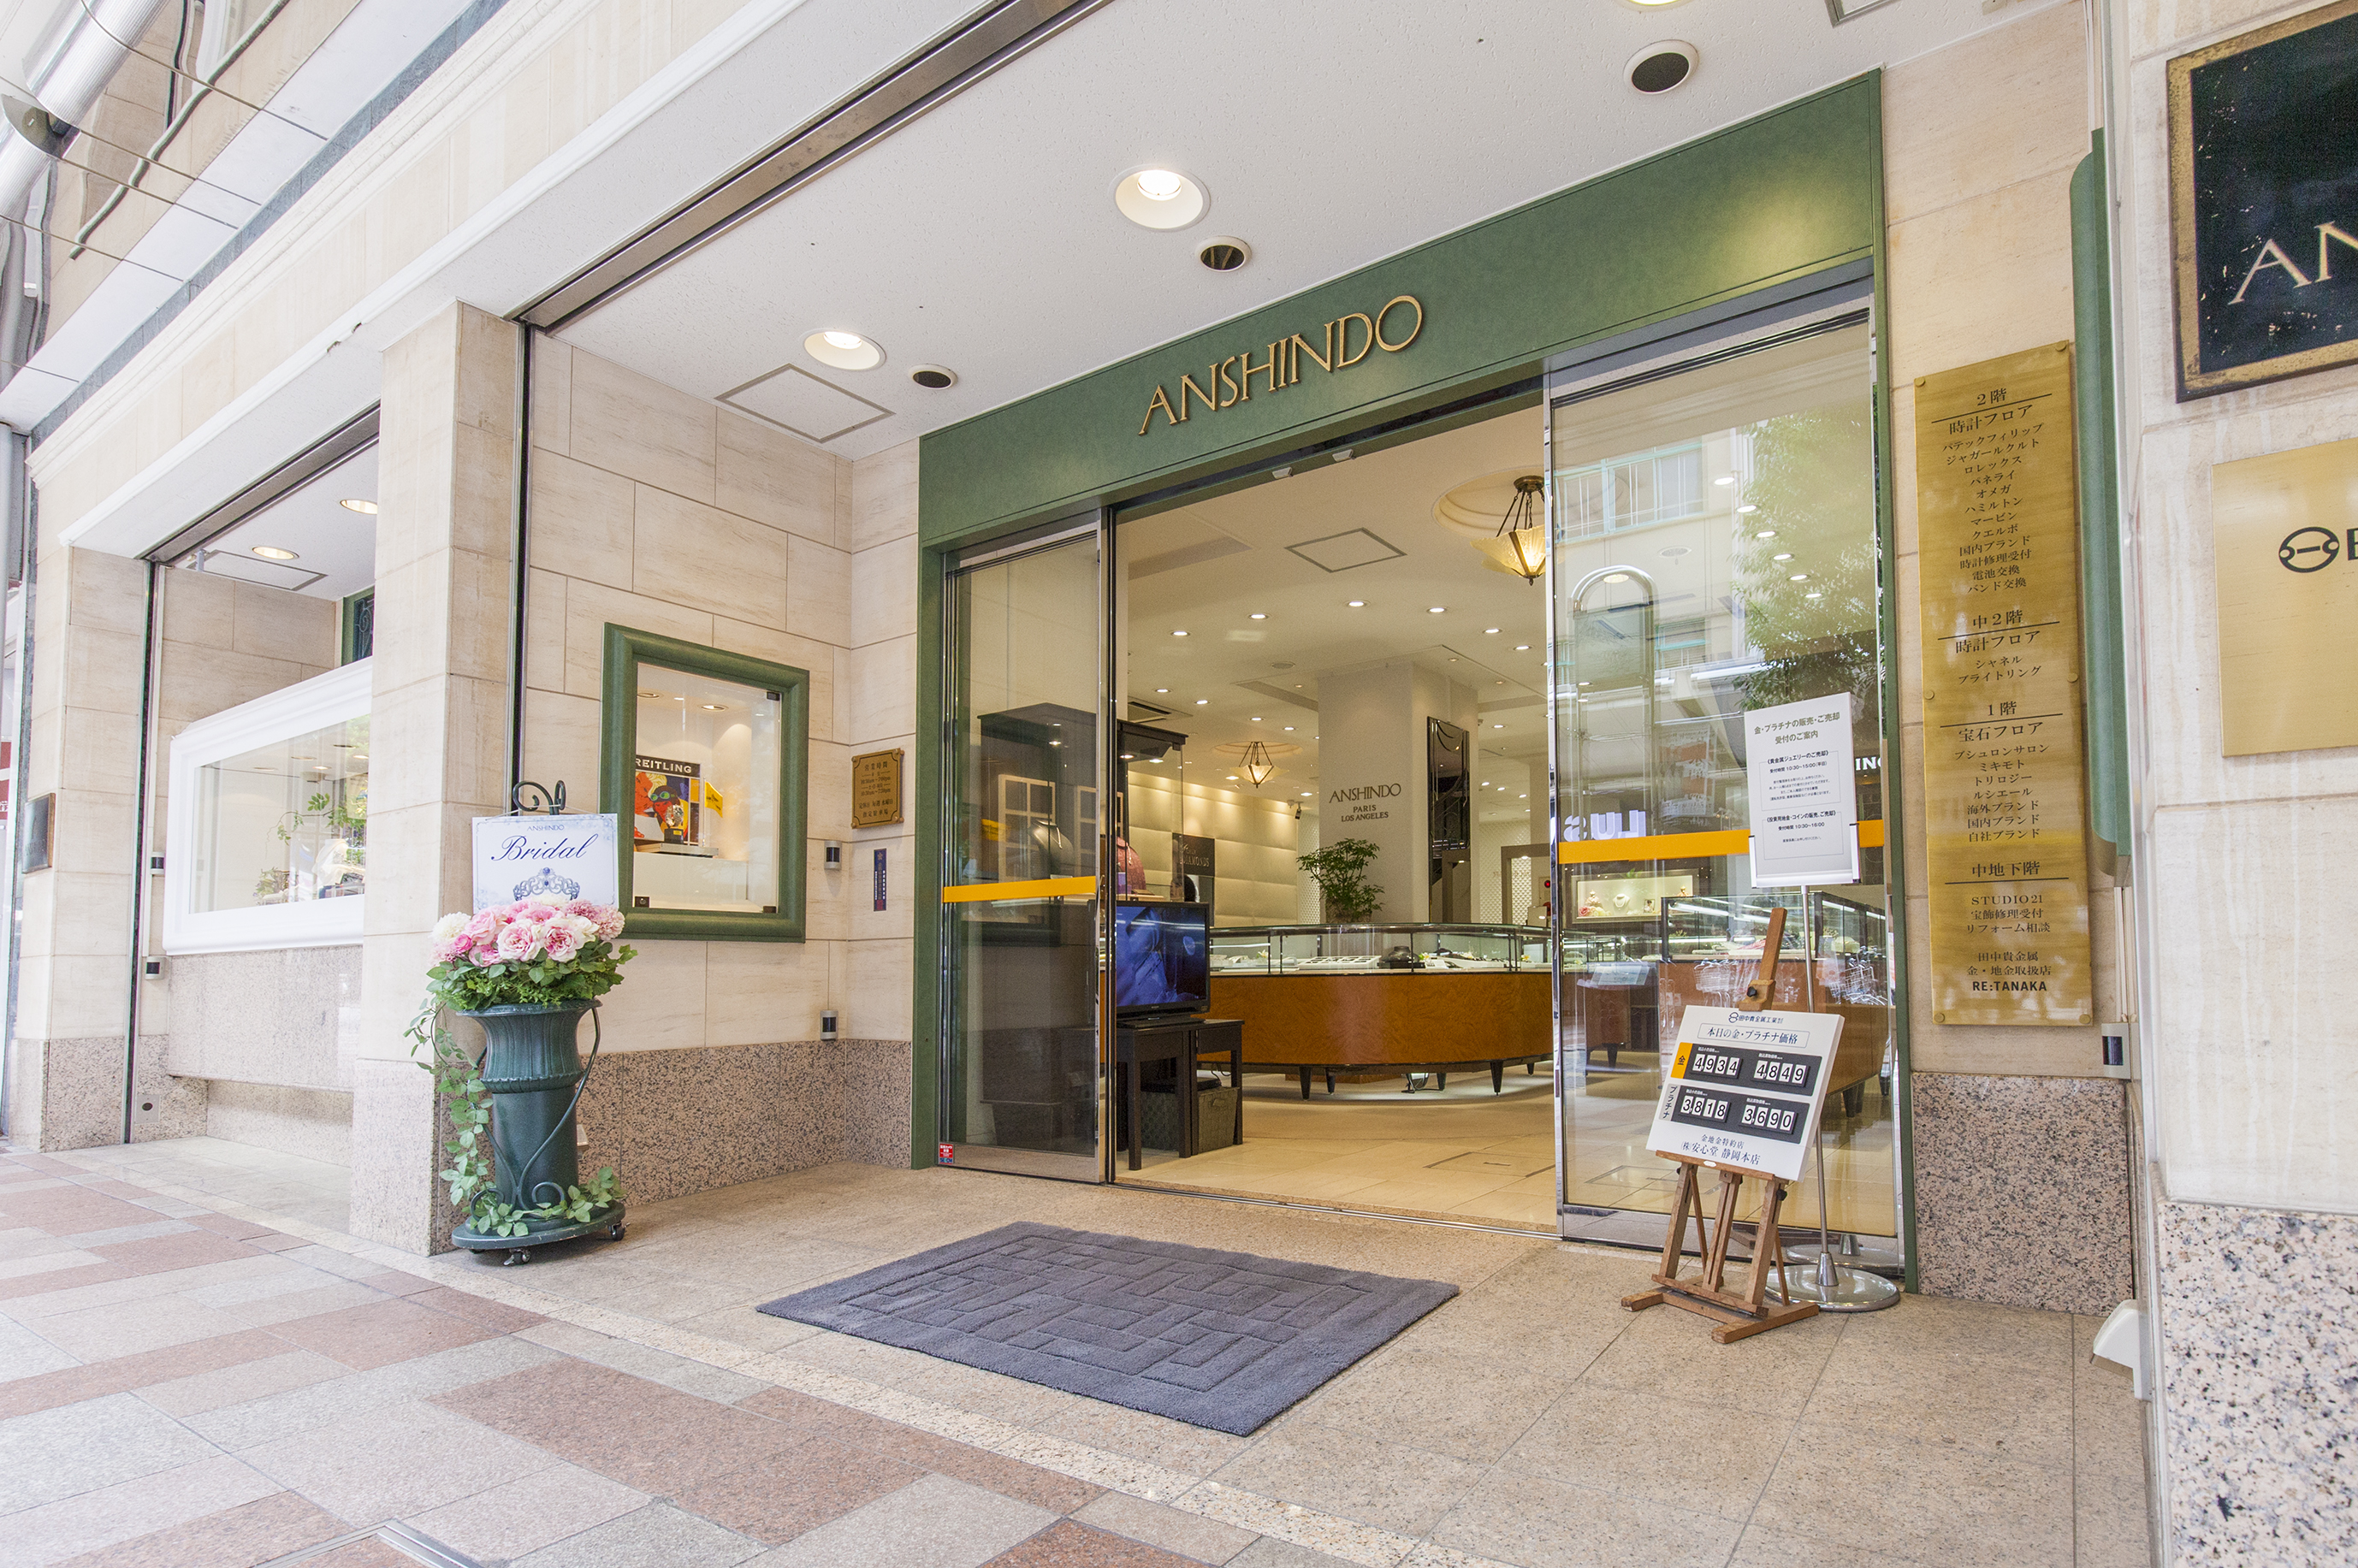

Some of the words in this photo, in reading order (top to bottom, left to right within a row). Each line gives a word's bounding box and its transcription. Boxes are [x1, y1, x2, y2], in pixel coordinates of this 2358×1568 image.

[1138, 295, 1423, 436] ANSHINDO
[1976, 388, 2007, 406] 2階
[1949, 405, 2033, 435] 時計フロア
[1942, 423, 2044, 452] パテックフィリップ
[1946, 437, 2040, 466] ジャガールクルト
[1964, 455, 2023, 475] ロレックス
[1970, 470, 2016, 486] パネライ
[1976, 484, 2011, 500] オメガ
[1964, 497, 2023, 513] ハミルトン
[1971, 524, 2019, 540] クエルボ
[1959, 535, 2031, 557] 国内ブランド
[1959, 548, 2032, 571] 時計修理受付
[1971, 565, 2020, 582] 電池交換
[1968, 577, 2027, 594] バンド交換
[1972, 610, 2023, 630] 中2階
[1955, 630, 2041, 654] 時計フロア
[1976, 655, 2023, 670] シャネル
[1958, 666, 2041, 684] ブライトリング
[1987, 701, 2017, 717] 1階
[1774, 730, 1818, 744] 受付のご案内
[1958, 721, 2043, 743] 宝石フロア
[1954, 744, 2049, 761] ブシュロンサロン
[1980, 759, 2024, 772] ミキモト
[1975, 774, 2032, 787] トリロジー
[1329, 783, 1401, 803] ANSHINDO
[1973, 787, 2033, 801] ルシエール
[1355, 812, 1389, 820] ANGELES
[1967, 800, 2039, 816] 海外ブランド
[1967, 814, 2040, 829] 国内ブランド
[1969, 828, 2040, 843] 自社ブランド
[491, 833, 599, 861] Bridal
[1971, 861, 2041, 878] 中地下階
[1970, 908, 2043, 920] 宝飾修理受付
[1967, 921, 2051, 934] リフォーム相談
[1978, 950, 2039, 962] 田中貴金属
[1972, 980, 2047, 991] RE:TANAKA
[1707, 1027, 1798, 1044] 本日の金・プラチナ価格
[1678, 1056, 1686, 1066] 金
[1663, 1086, 1677, 1119] プラチナ
[1721, 1149, 1761, 1165] 静岡本店
